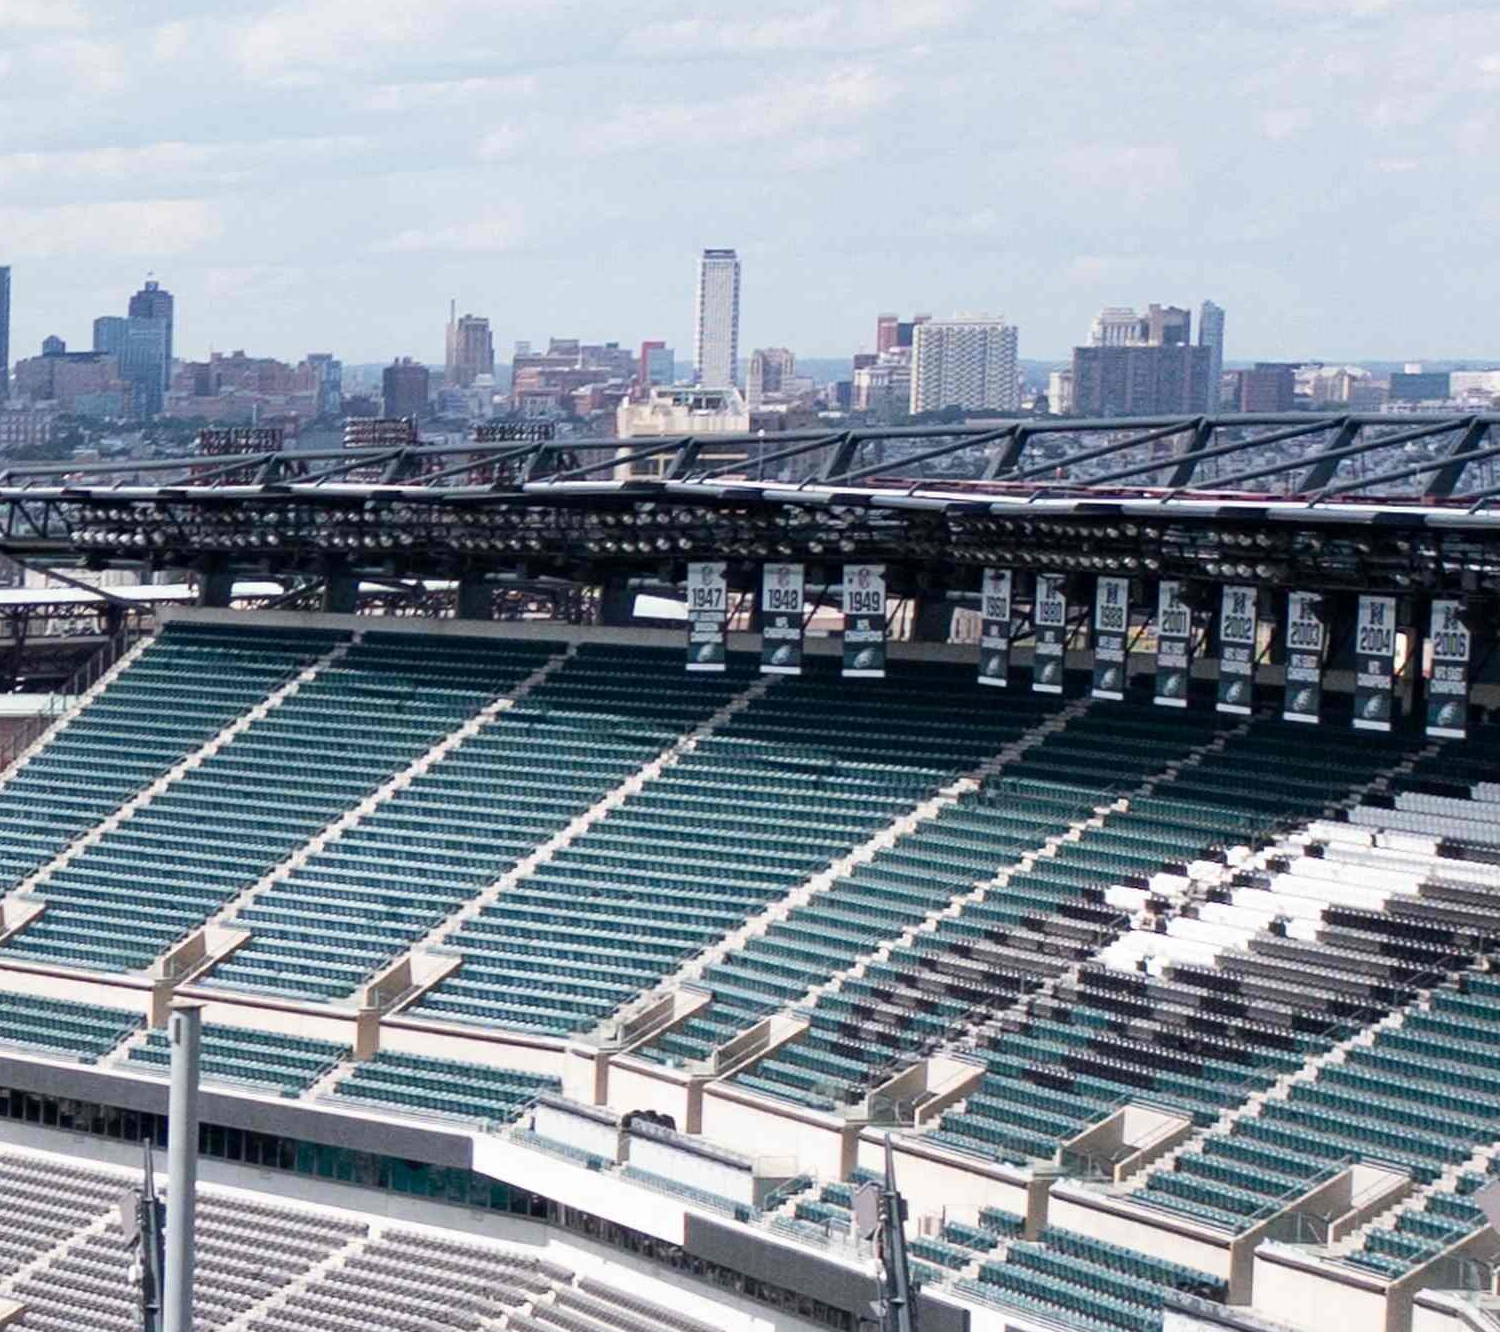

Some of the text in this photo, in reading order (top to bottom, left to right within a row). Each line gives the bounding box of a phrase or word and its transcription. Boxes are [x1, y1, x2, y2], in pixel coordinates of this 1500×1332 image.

[691, 588, 723, 608] 1947
[767, 589, 798, 610] 1948
[849, 591, 881, 612] 1949
[1223, 616, 1252, 639] 2002
[1360, 627, 1391, 652] 2004
